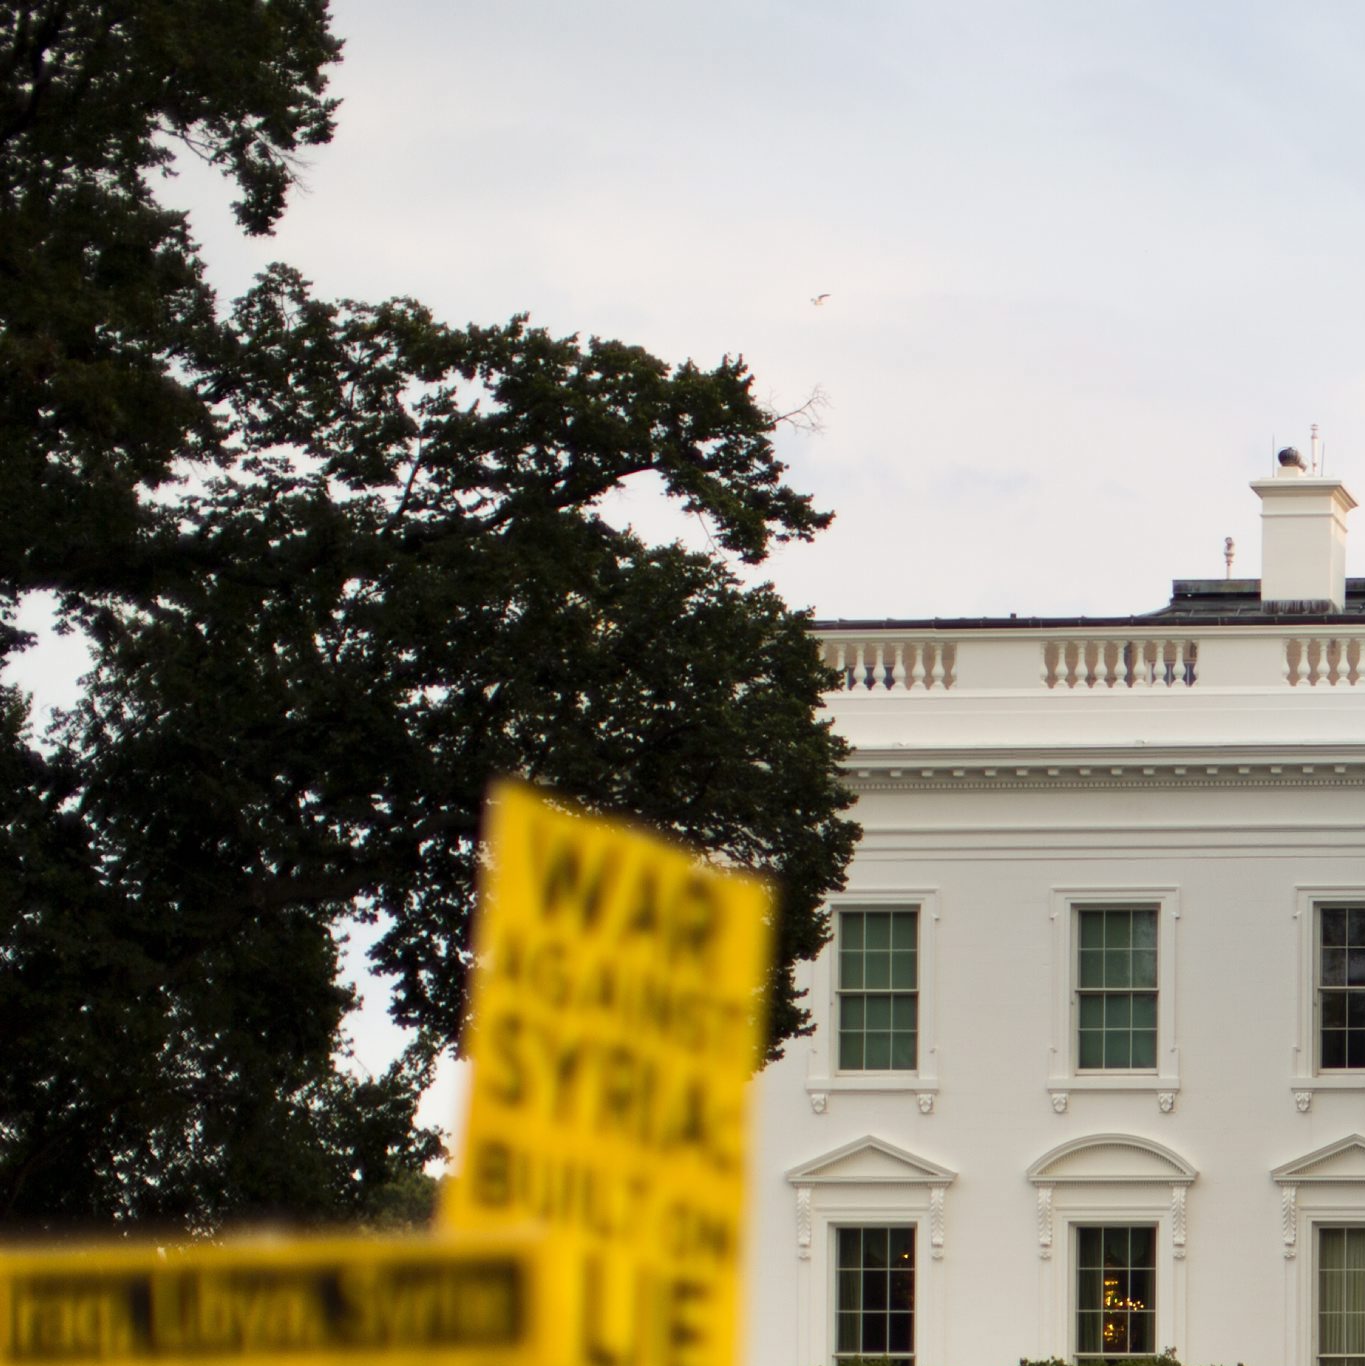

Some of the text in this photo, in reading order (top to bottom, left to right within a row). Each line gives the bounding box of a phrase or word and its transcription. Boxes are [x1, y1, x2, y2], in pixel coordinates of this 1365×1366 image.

[534, 815, 724, 952] WAR
[500, 926, 746, 1050] AGAINST
[472, 1136, 736, 1268] BUILT ON
